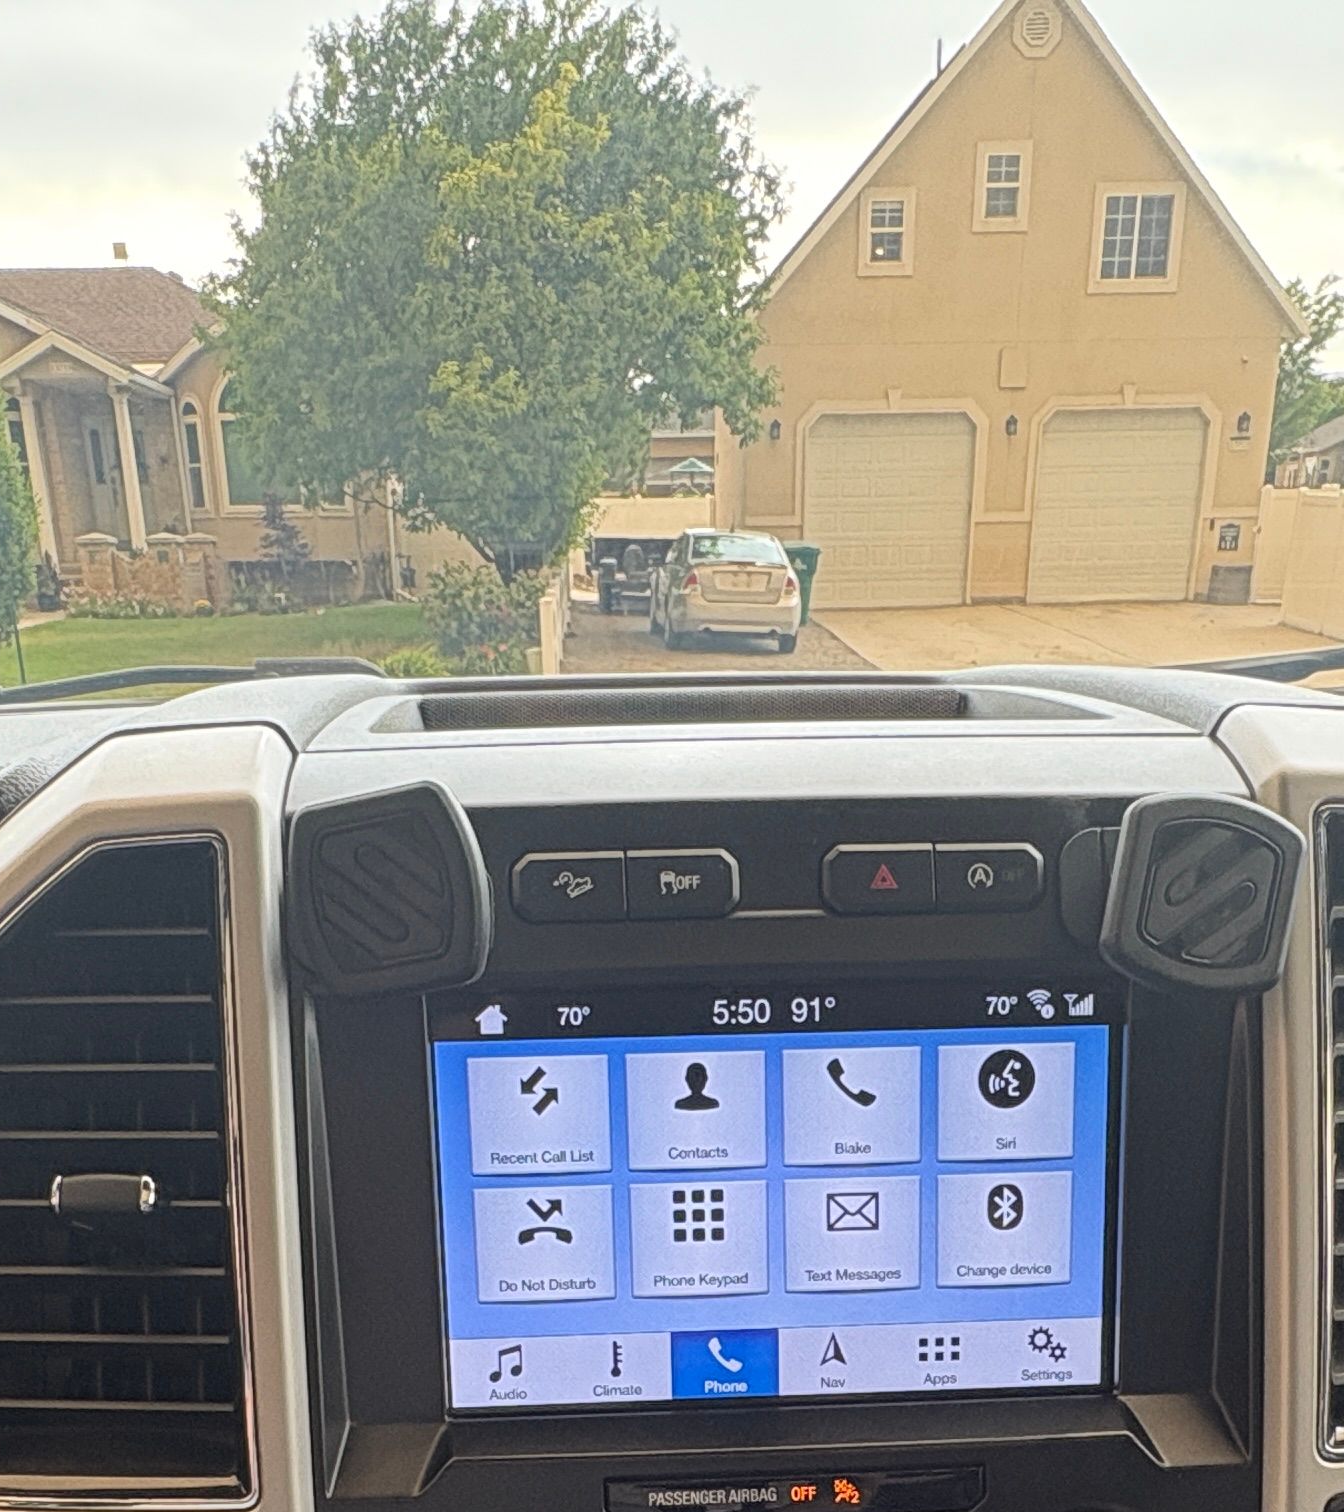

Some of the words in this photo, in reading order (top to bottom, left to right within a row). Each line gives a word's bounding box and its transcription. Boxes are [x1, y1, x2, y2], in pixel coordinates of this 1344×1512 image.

[676, 875, 701, 890] OFF
[712, 999, 771, 1025] 5:50
[791, 996, 836, 1023] 91°
[985, 996, 1018, 1015] 70°
[557, 1006, 591, 1026] 70°
[834, 1142, 872, 1155] Blake
[995, 1137, 1017, 1150] Siri
[490, 1152, 538, 1165] Recent
[541, 1150, 567, 1164] Call
[570, 1149, 595, 1163] List
[668, 1147, 728, 1160] Contacts
[806, 1269, 832, 1282] Text
[836, 1268, 902, 1283] Messages
[957, 1265, 1006, 1279] Change
[1010, 1263, 1052, 1276] device
[499, 1280, 517, 1292] Do
[522, 1279, 545, 1291] Not
[549, 1277, 596, 1291] Disturb
[653, 1274, 695, 1287] Phone
[699, 1273, 749, 1288] Keypad
[821, 1377, 846, 1389] Nav
[923, 1373, 957, 1387] Apps
[1021, 1369, 1073, 1383] Settings
[489, 1388, 527, 1401] Audio
[593, 1384, 642, 1398] Climate
[704, 1381, 748, 1394] Phone
[649, 1488, 727, 1507] PASSENGER
[729, 1487, 777, 1504] AIRBAG
[791, 1486, 817, 1501] OFF
